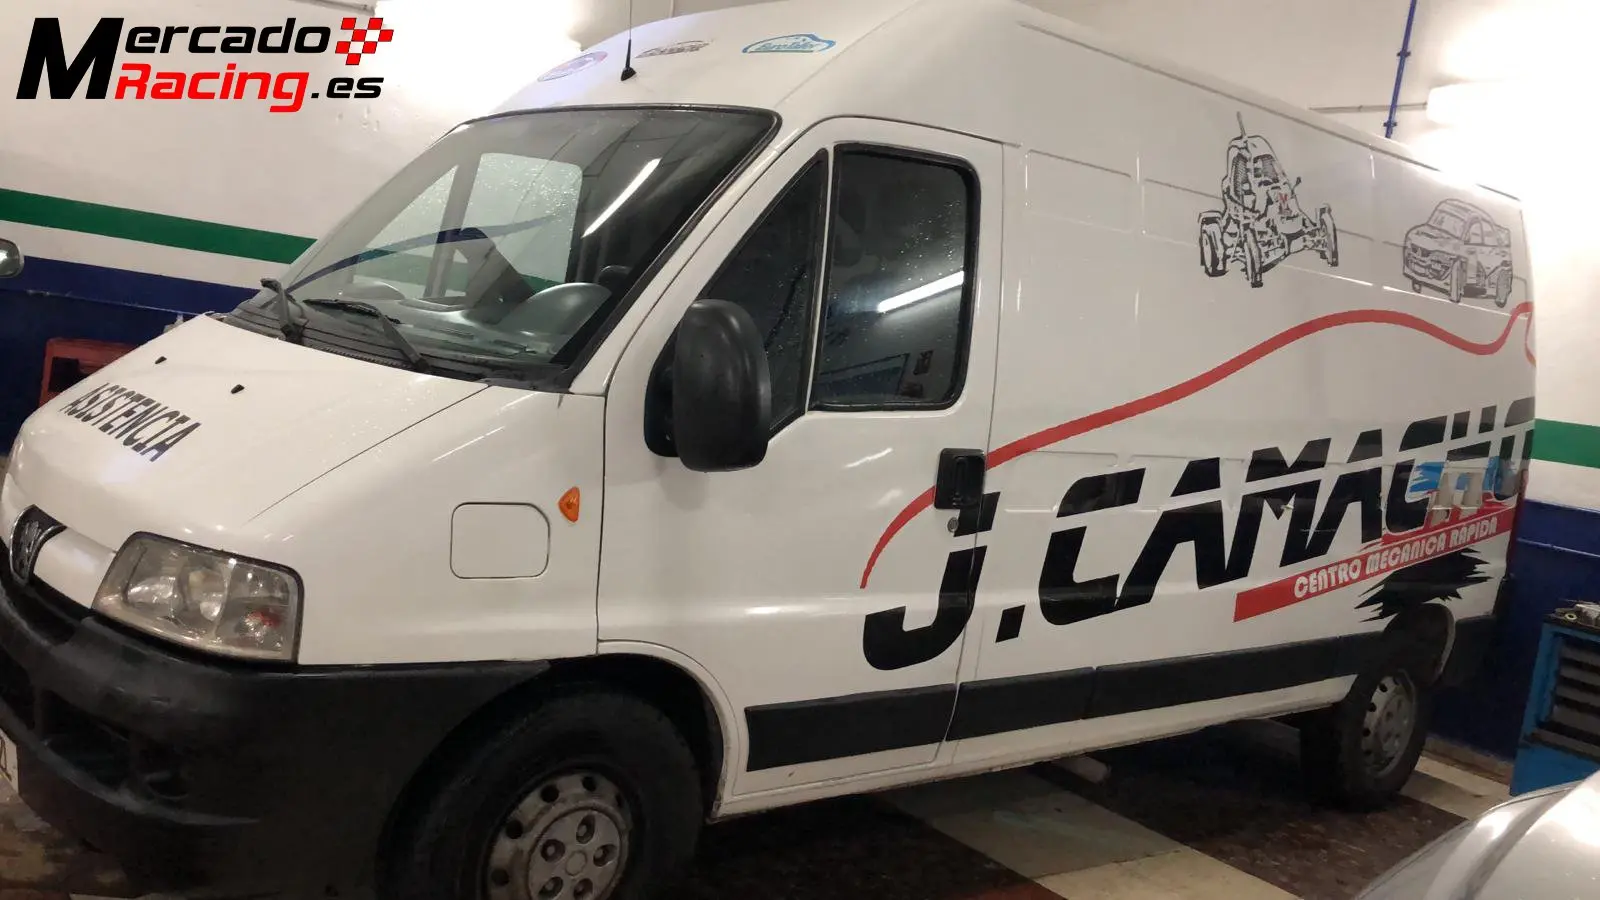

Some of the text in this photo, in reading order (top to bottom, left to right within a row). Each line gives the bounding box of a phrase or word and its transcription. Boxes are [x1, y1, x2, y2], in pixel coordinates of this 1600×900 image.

[59, 382, 202, 462] ASISTENCIA
[1293, 516, 1498, 599] CENTRO MECANICA RAPIDA
